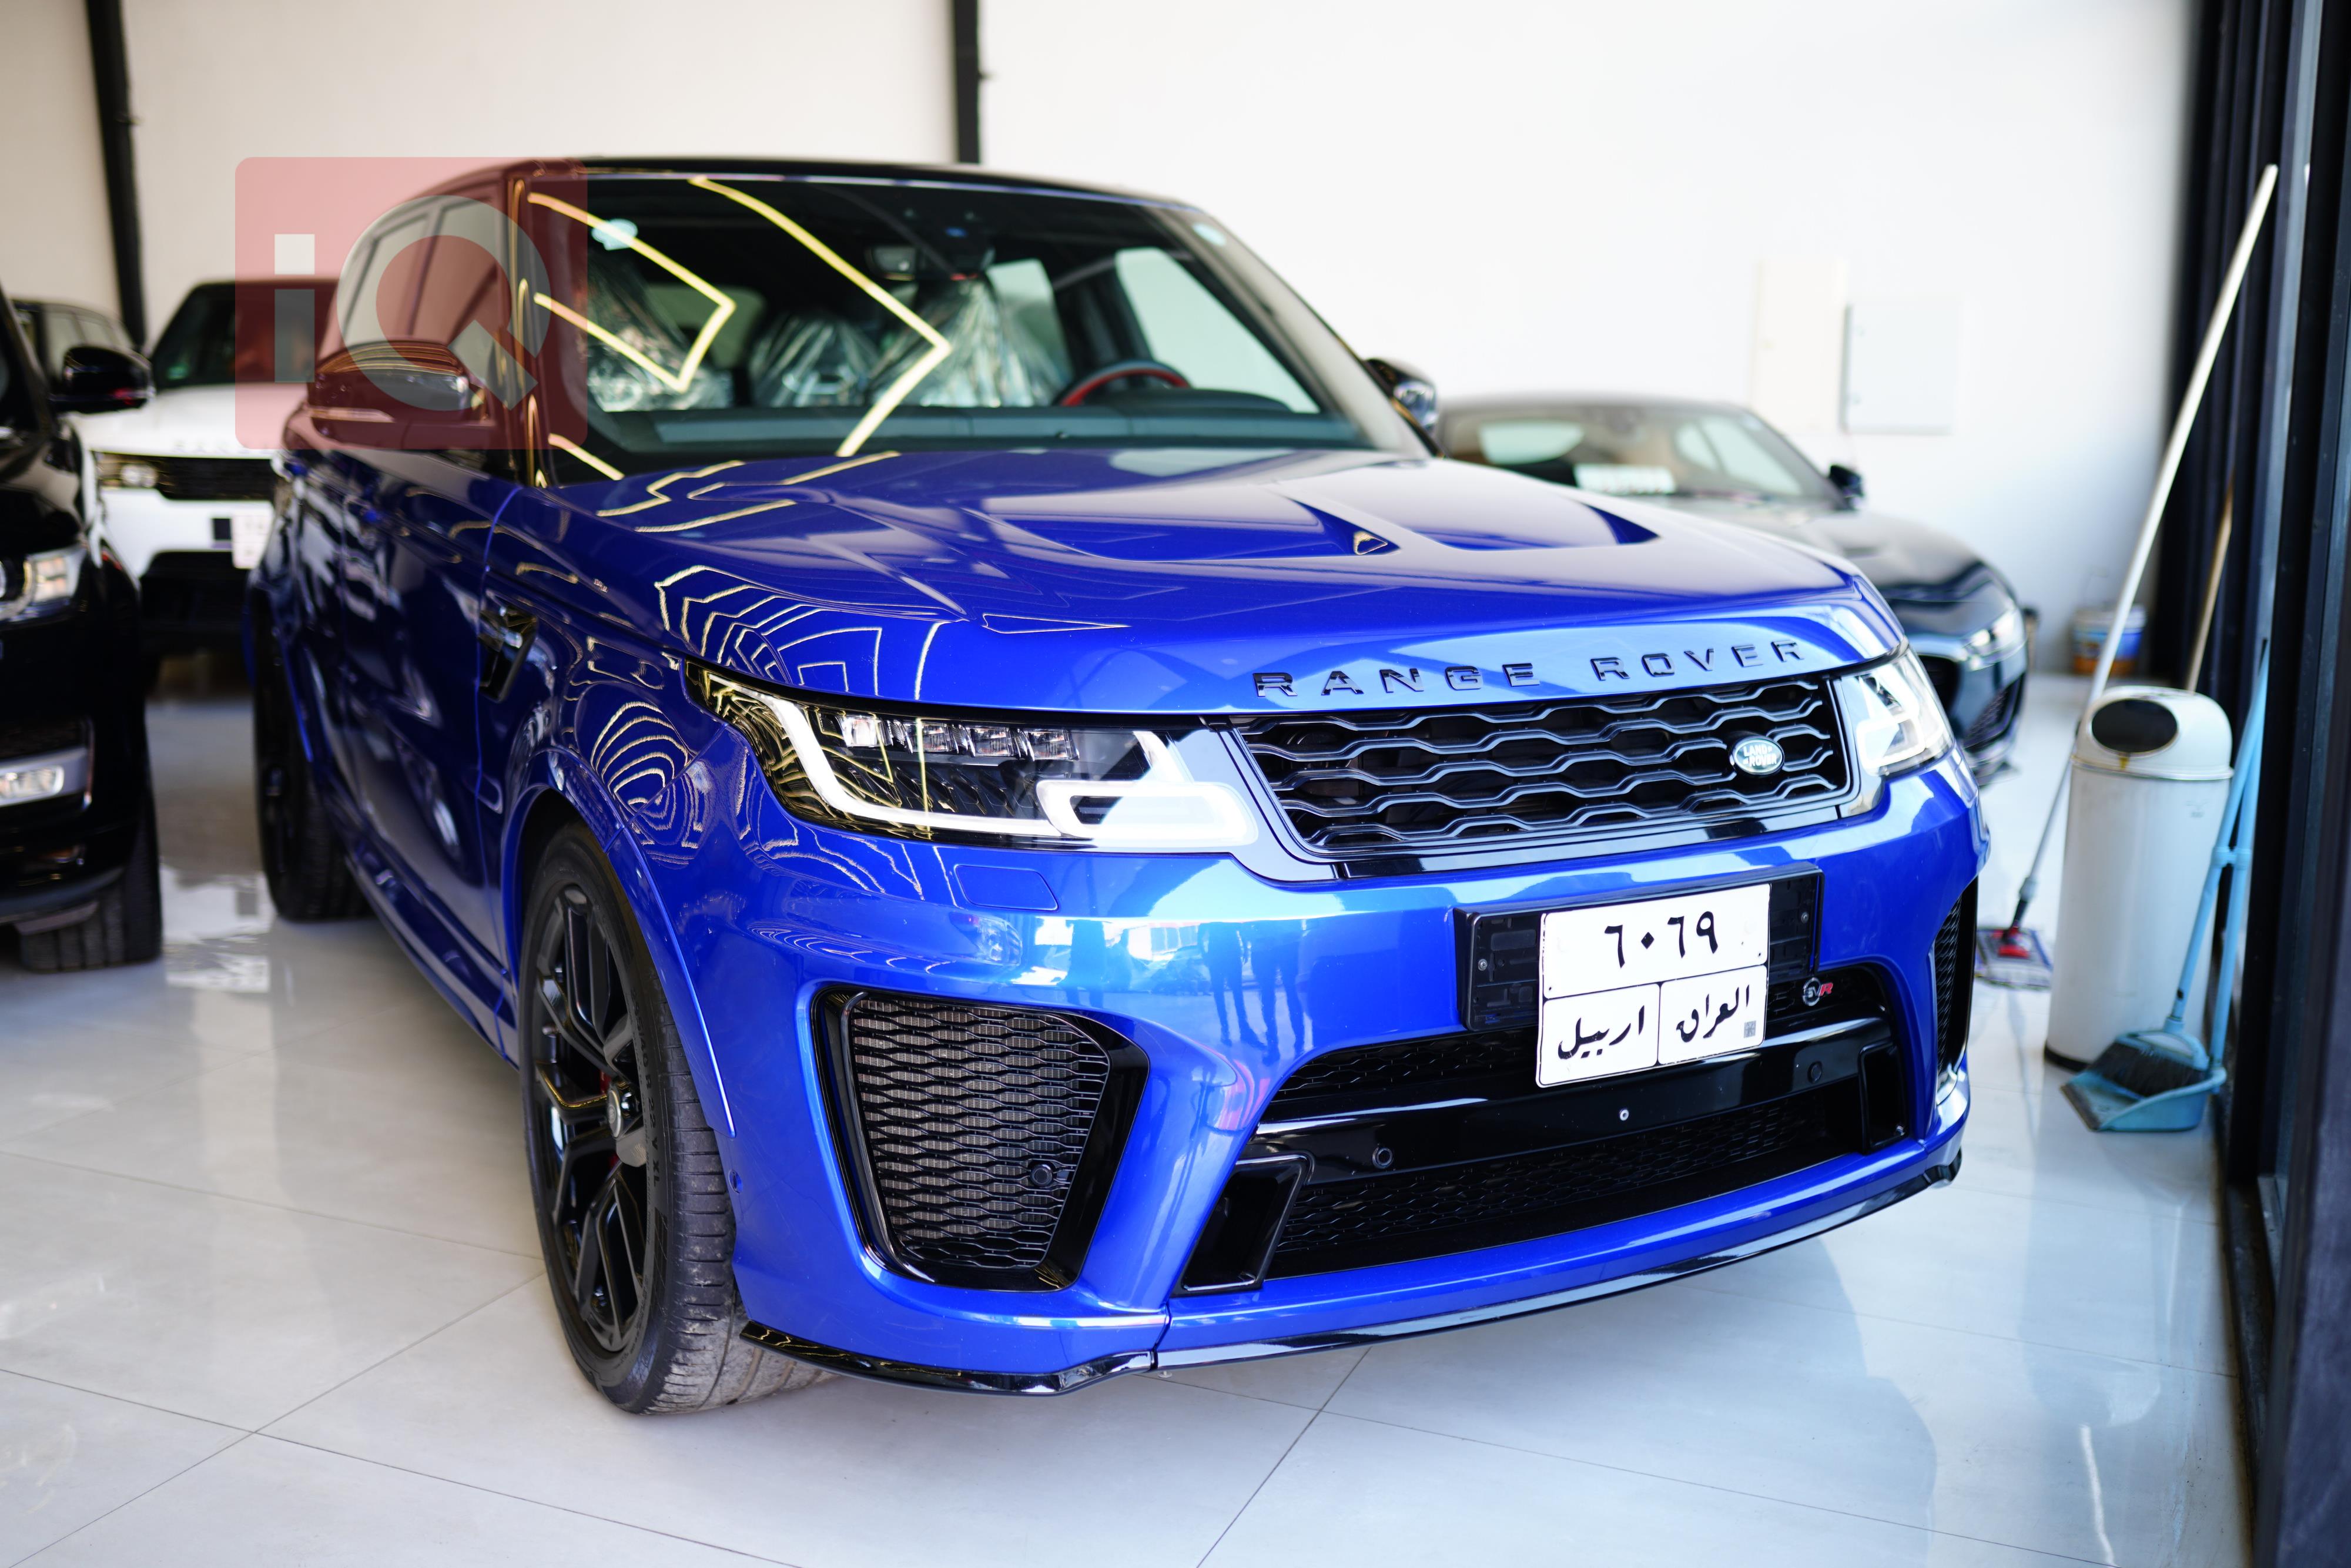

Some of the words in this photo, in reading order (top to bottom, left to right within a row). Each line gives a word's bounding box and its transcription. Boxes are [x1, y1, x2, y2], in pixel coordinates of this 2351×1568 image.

[1252, 663, 1540, 698] RANGE
[1590, 639, 1805, 681] ROVER
[1743, 743, 1768, 756] LAND
[1749, 753, 1777, 766] ROVER
[1605, 911, 1717, 968] ٦٠٦٩
[1676, 984, 1750, 1043] العراق
[648, 1097, 656, 1129] 22
[652, 1159, 659, 1187] XL
